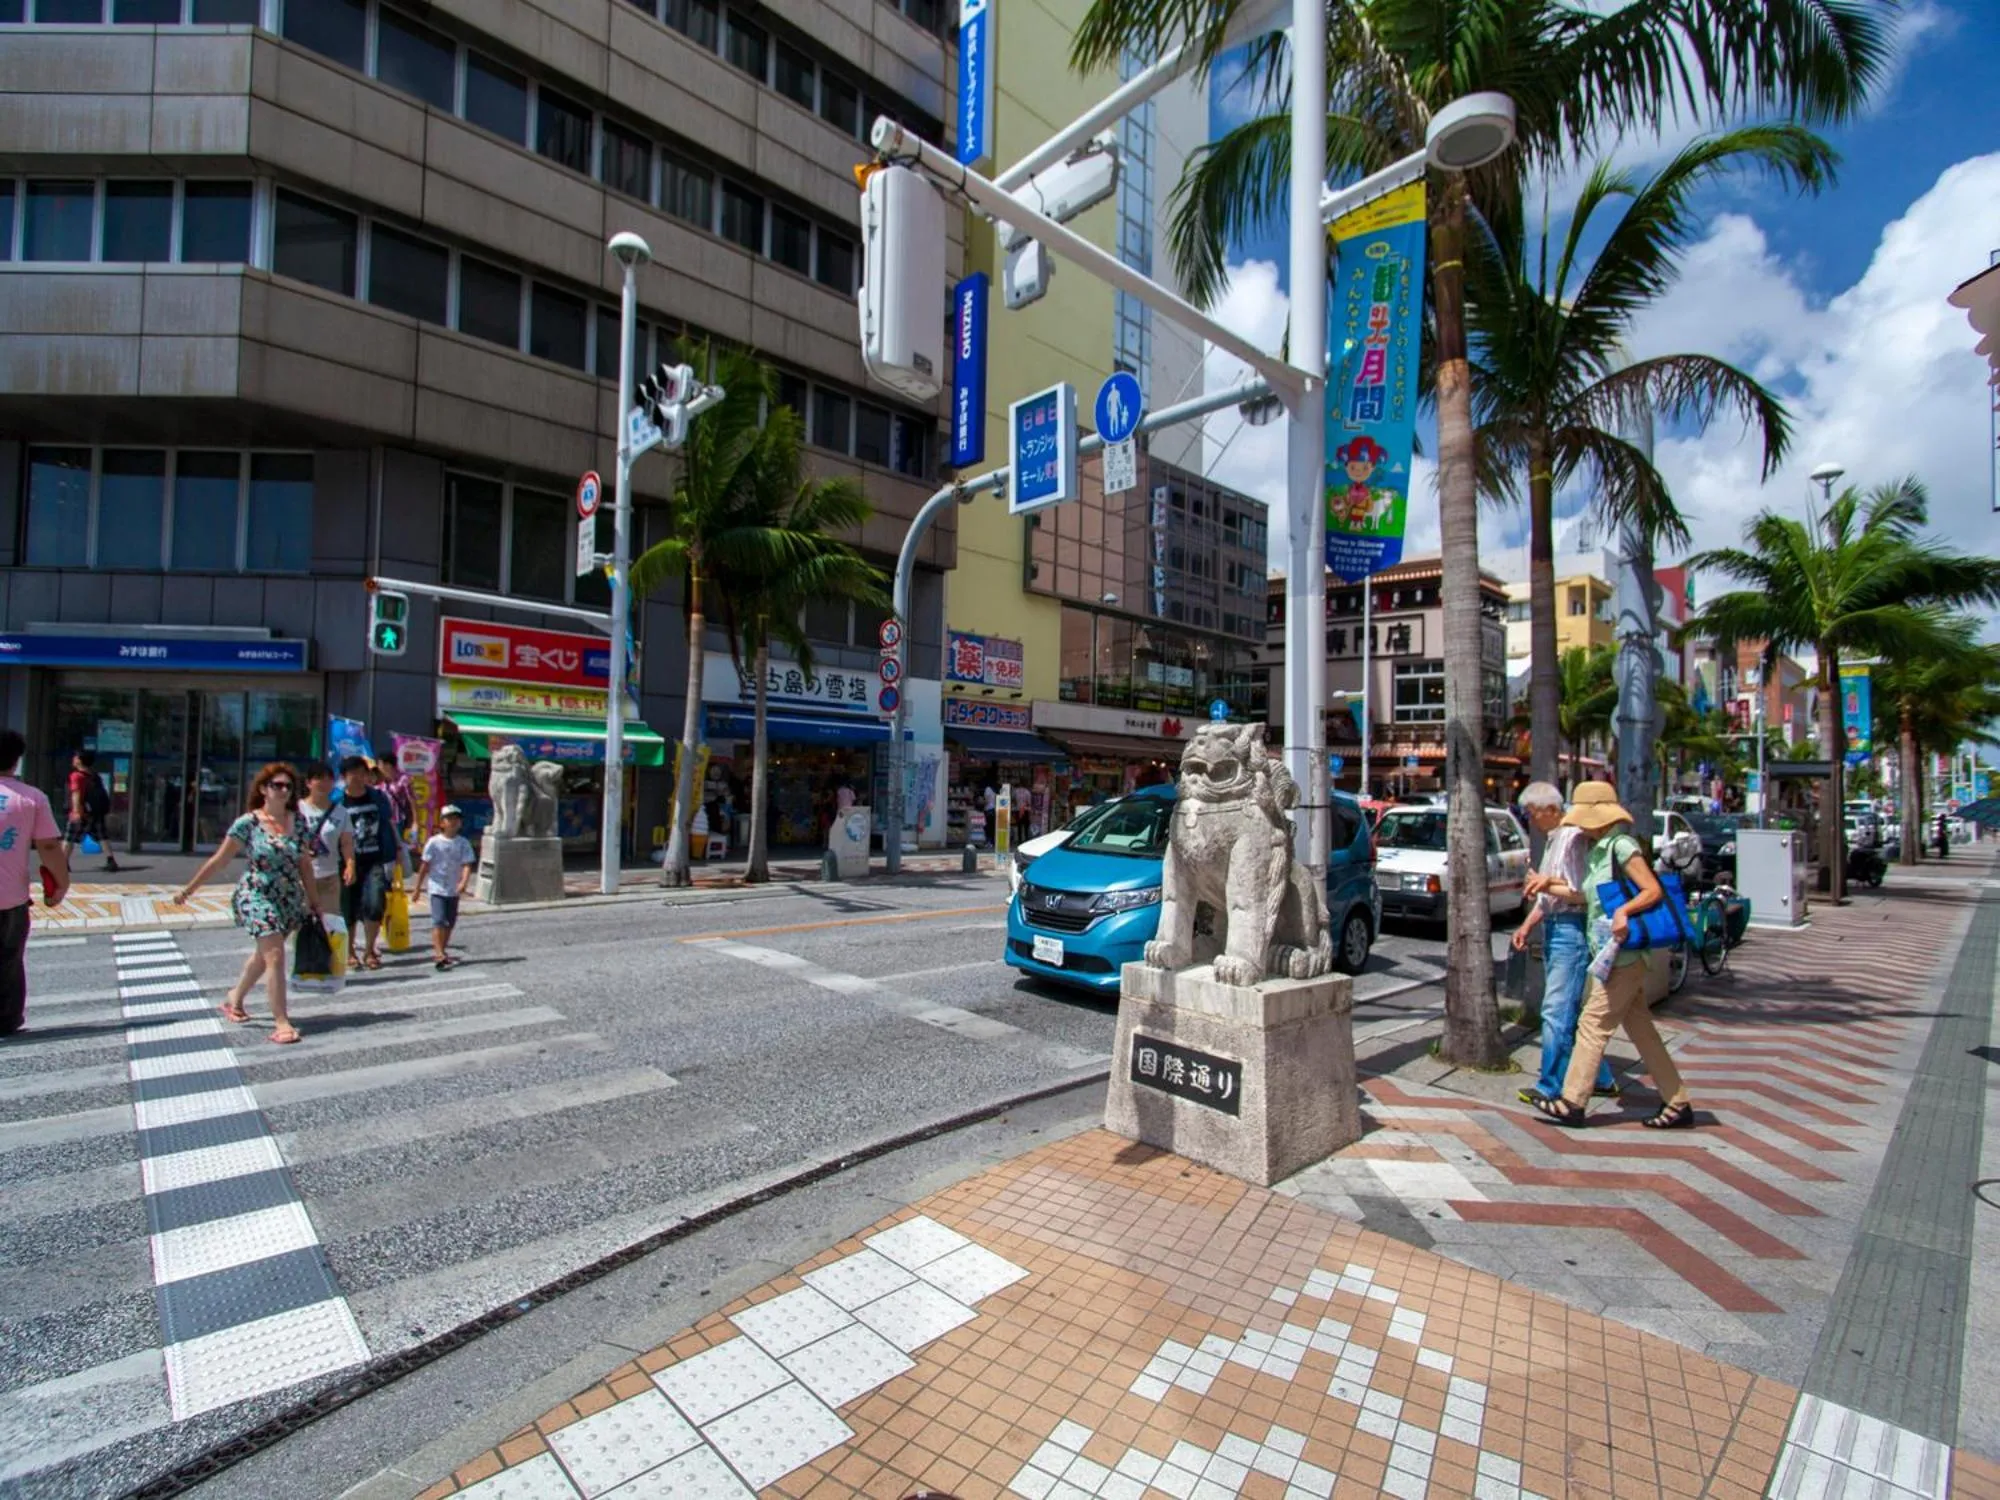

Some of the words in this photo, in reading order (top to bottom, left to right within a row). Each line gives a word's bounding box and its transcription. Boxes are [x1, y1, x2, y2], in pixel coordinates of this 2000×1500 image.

[961, 289, 974, 360] MIZUHO
[119, 645, 168, 658] みずほ銀行
[515, 644, 579, 672] 宝くじ
[952, 638, 984, 679] 薬
[1138, 1047, 1233, 1099] 国際通り
